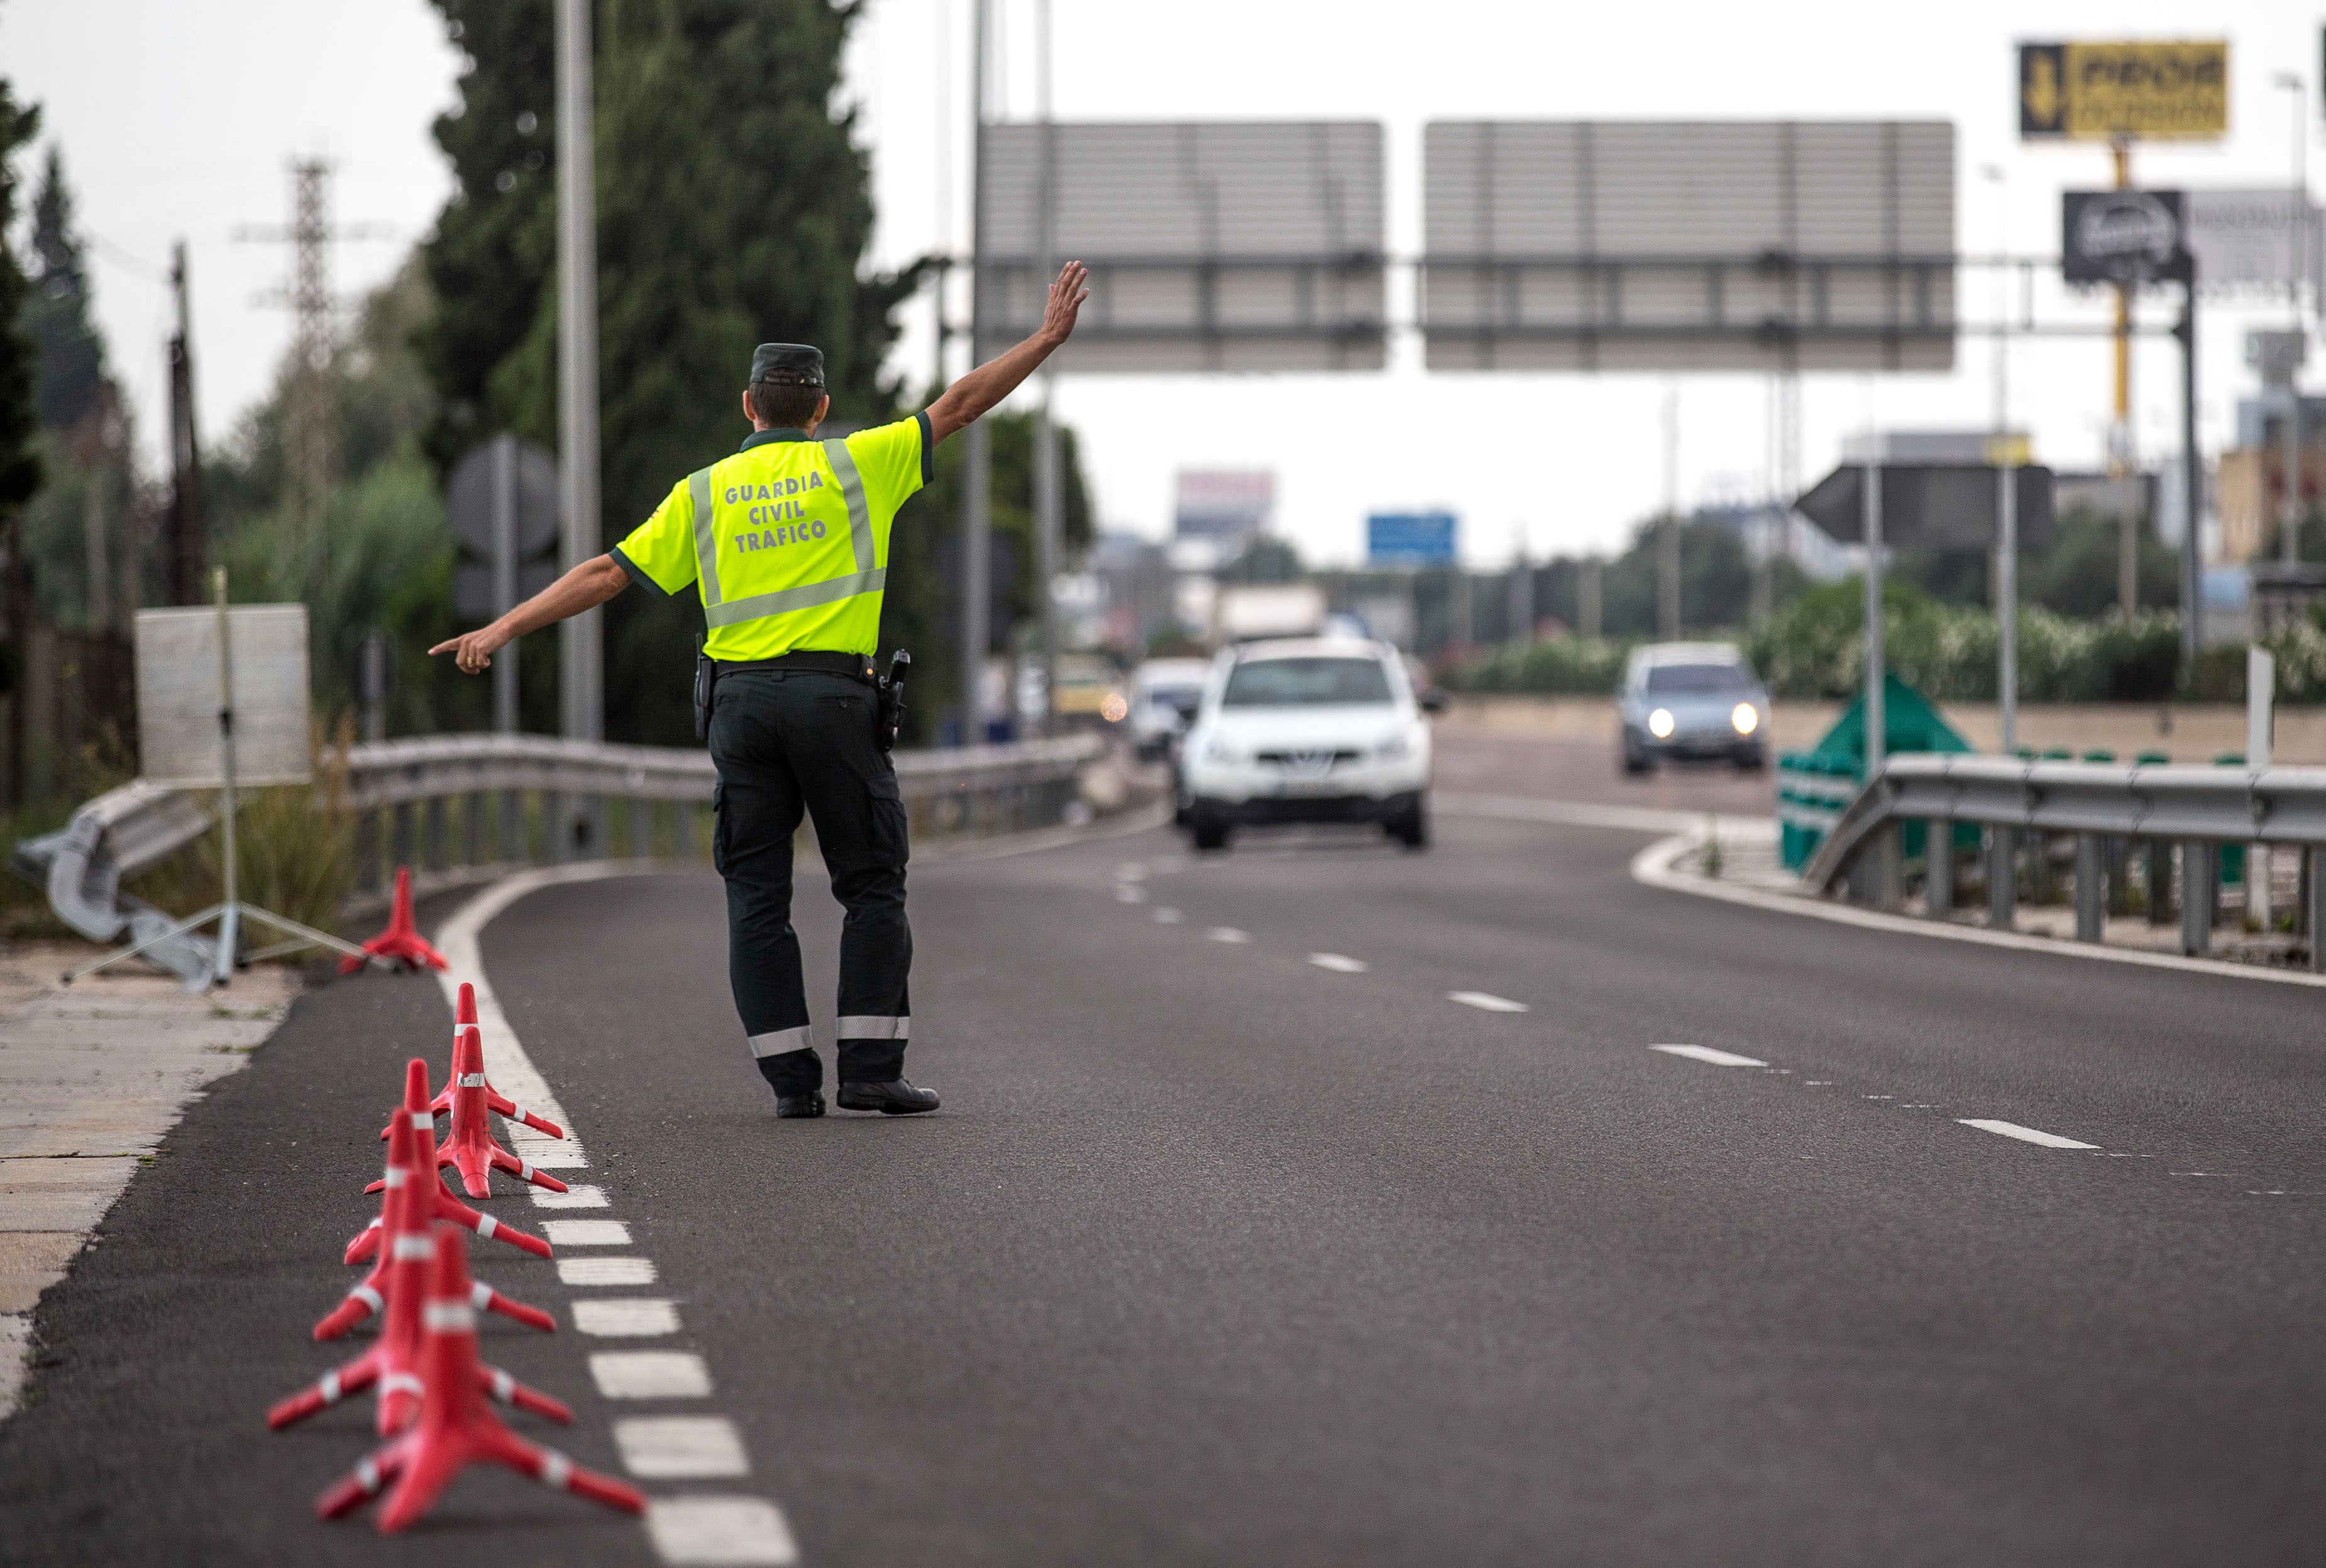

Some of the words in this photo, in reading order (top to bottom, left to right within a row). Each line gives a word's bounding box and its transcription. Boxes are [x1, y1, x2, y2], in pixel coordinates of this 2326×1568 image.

[725, 472, 824, 504] GUARDIA
[749, 500, 805, 525] CIVIL
[735, 520, 826, 553] TRAFICO
